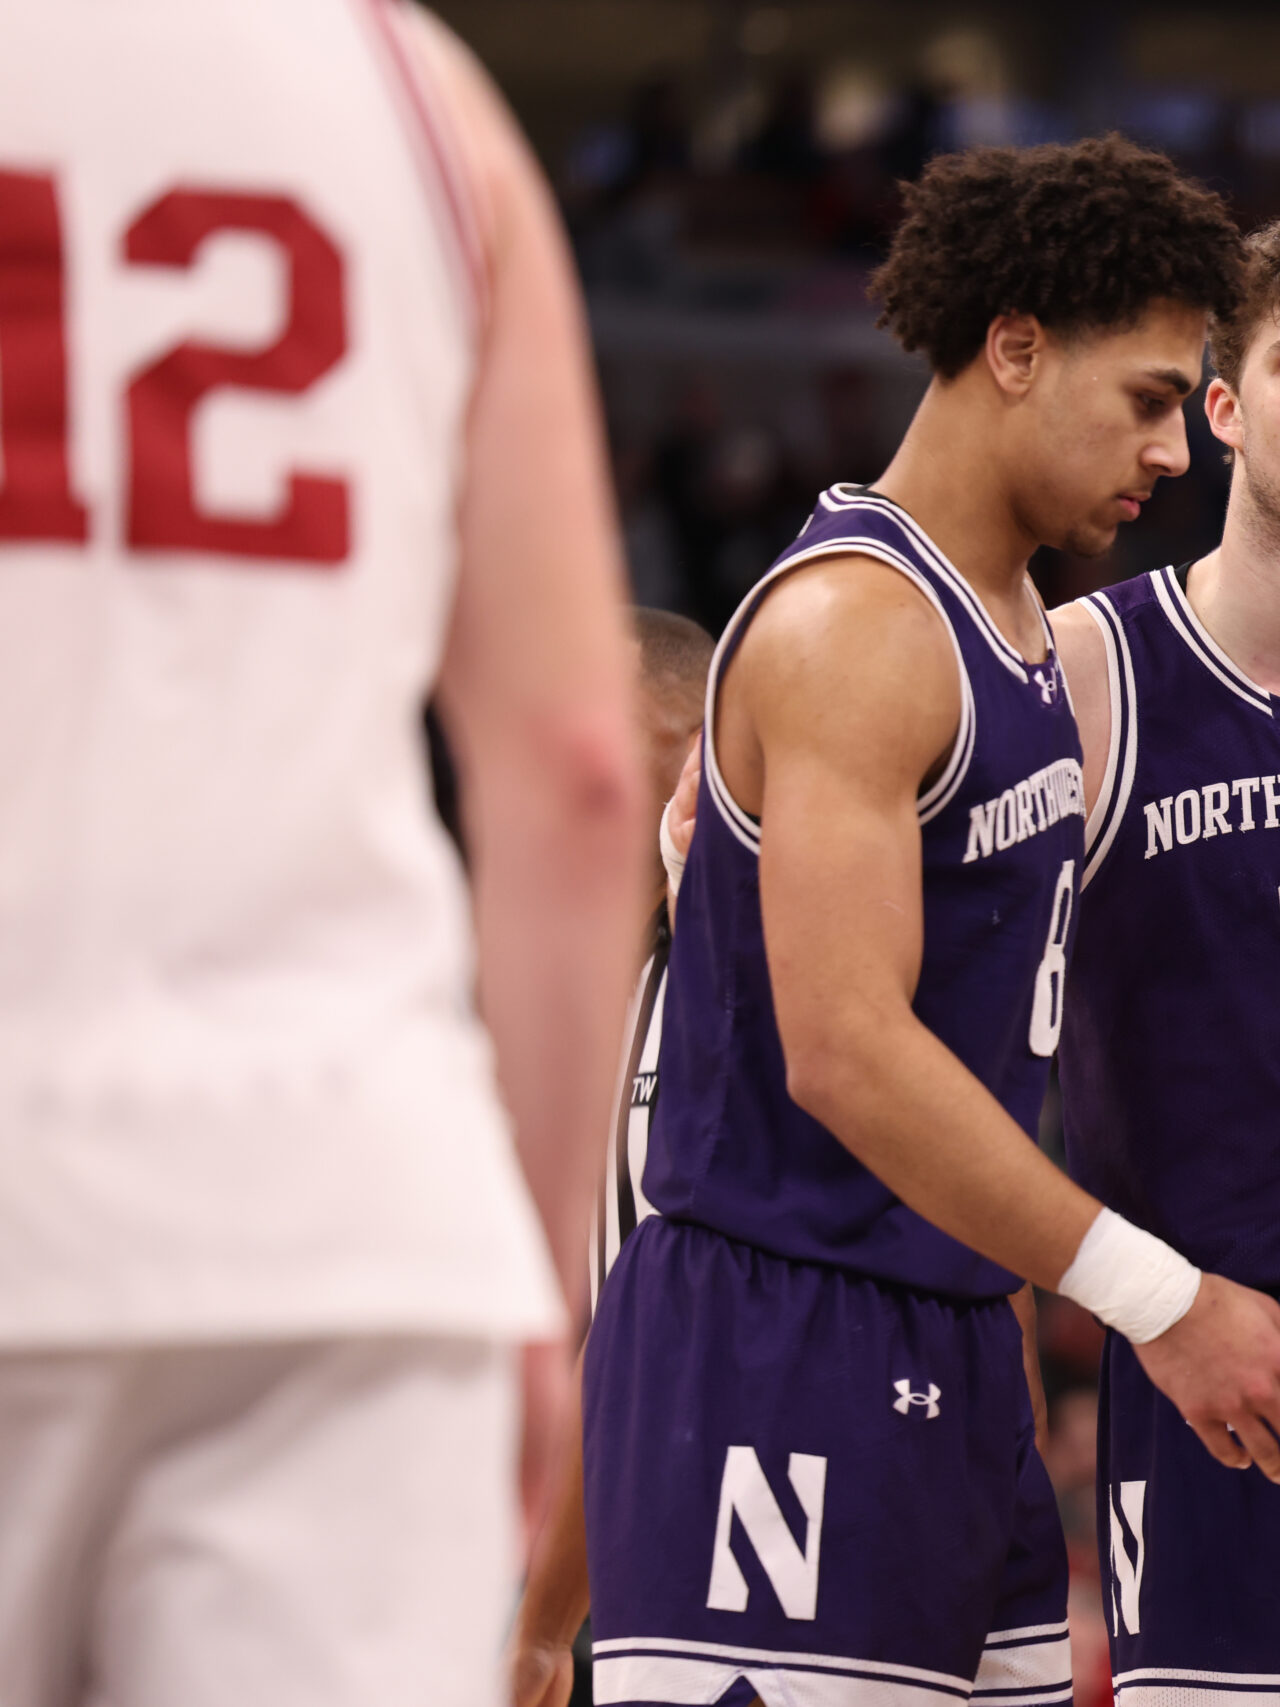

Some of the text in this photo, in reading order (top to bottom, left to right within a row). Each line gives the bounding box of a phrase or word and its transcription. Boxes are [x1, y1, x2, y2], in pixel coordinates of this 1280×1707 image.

[0, 164, 352, 570] 12
[1028, 859, 1075, 1057] 8
[706, 1445, 827, 1620] N
